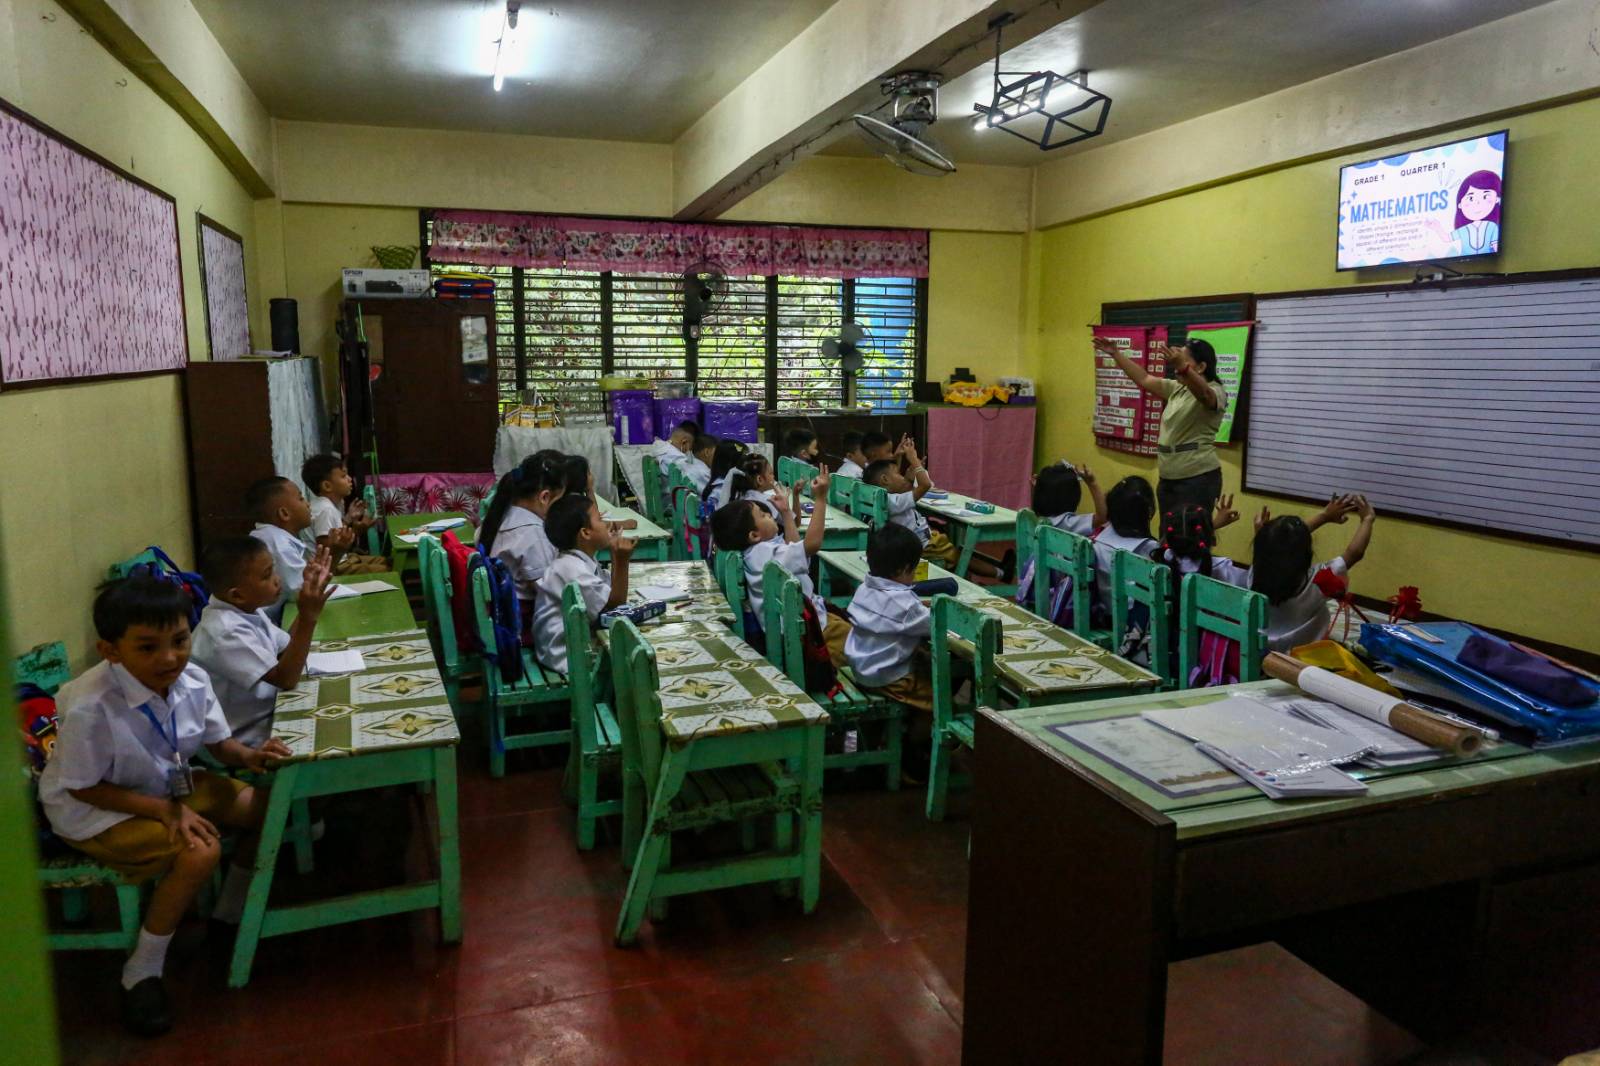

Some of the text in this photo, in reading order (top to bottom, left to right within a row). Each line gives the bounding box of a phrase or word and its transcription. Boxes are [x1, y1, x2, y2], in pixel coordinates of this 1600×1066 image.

[1400, 163, 1438, 176] QUARTER
[1354, 175, 1379, 185] GRADE
[1350, 189, 1449, 224] MATHEMATICS
